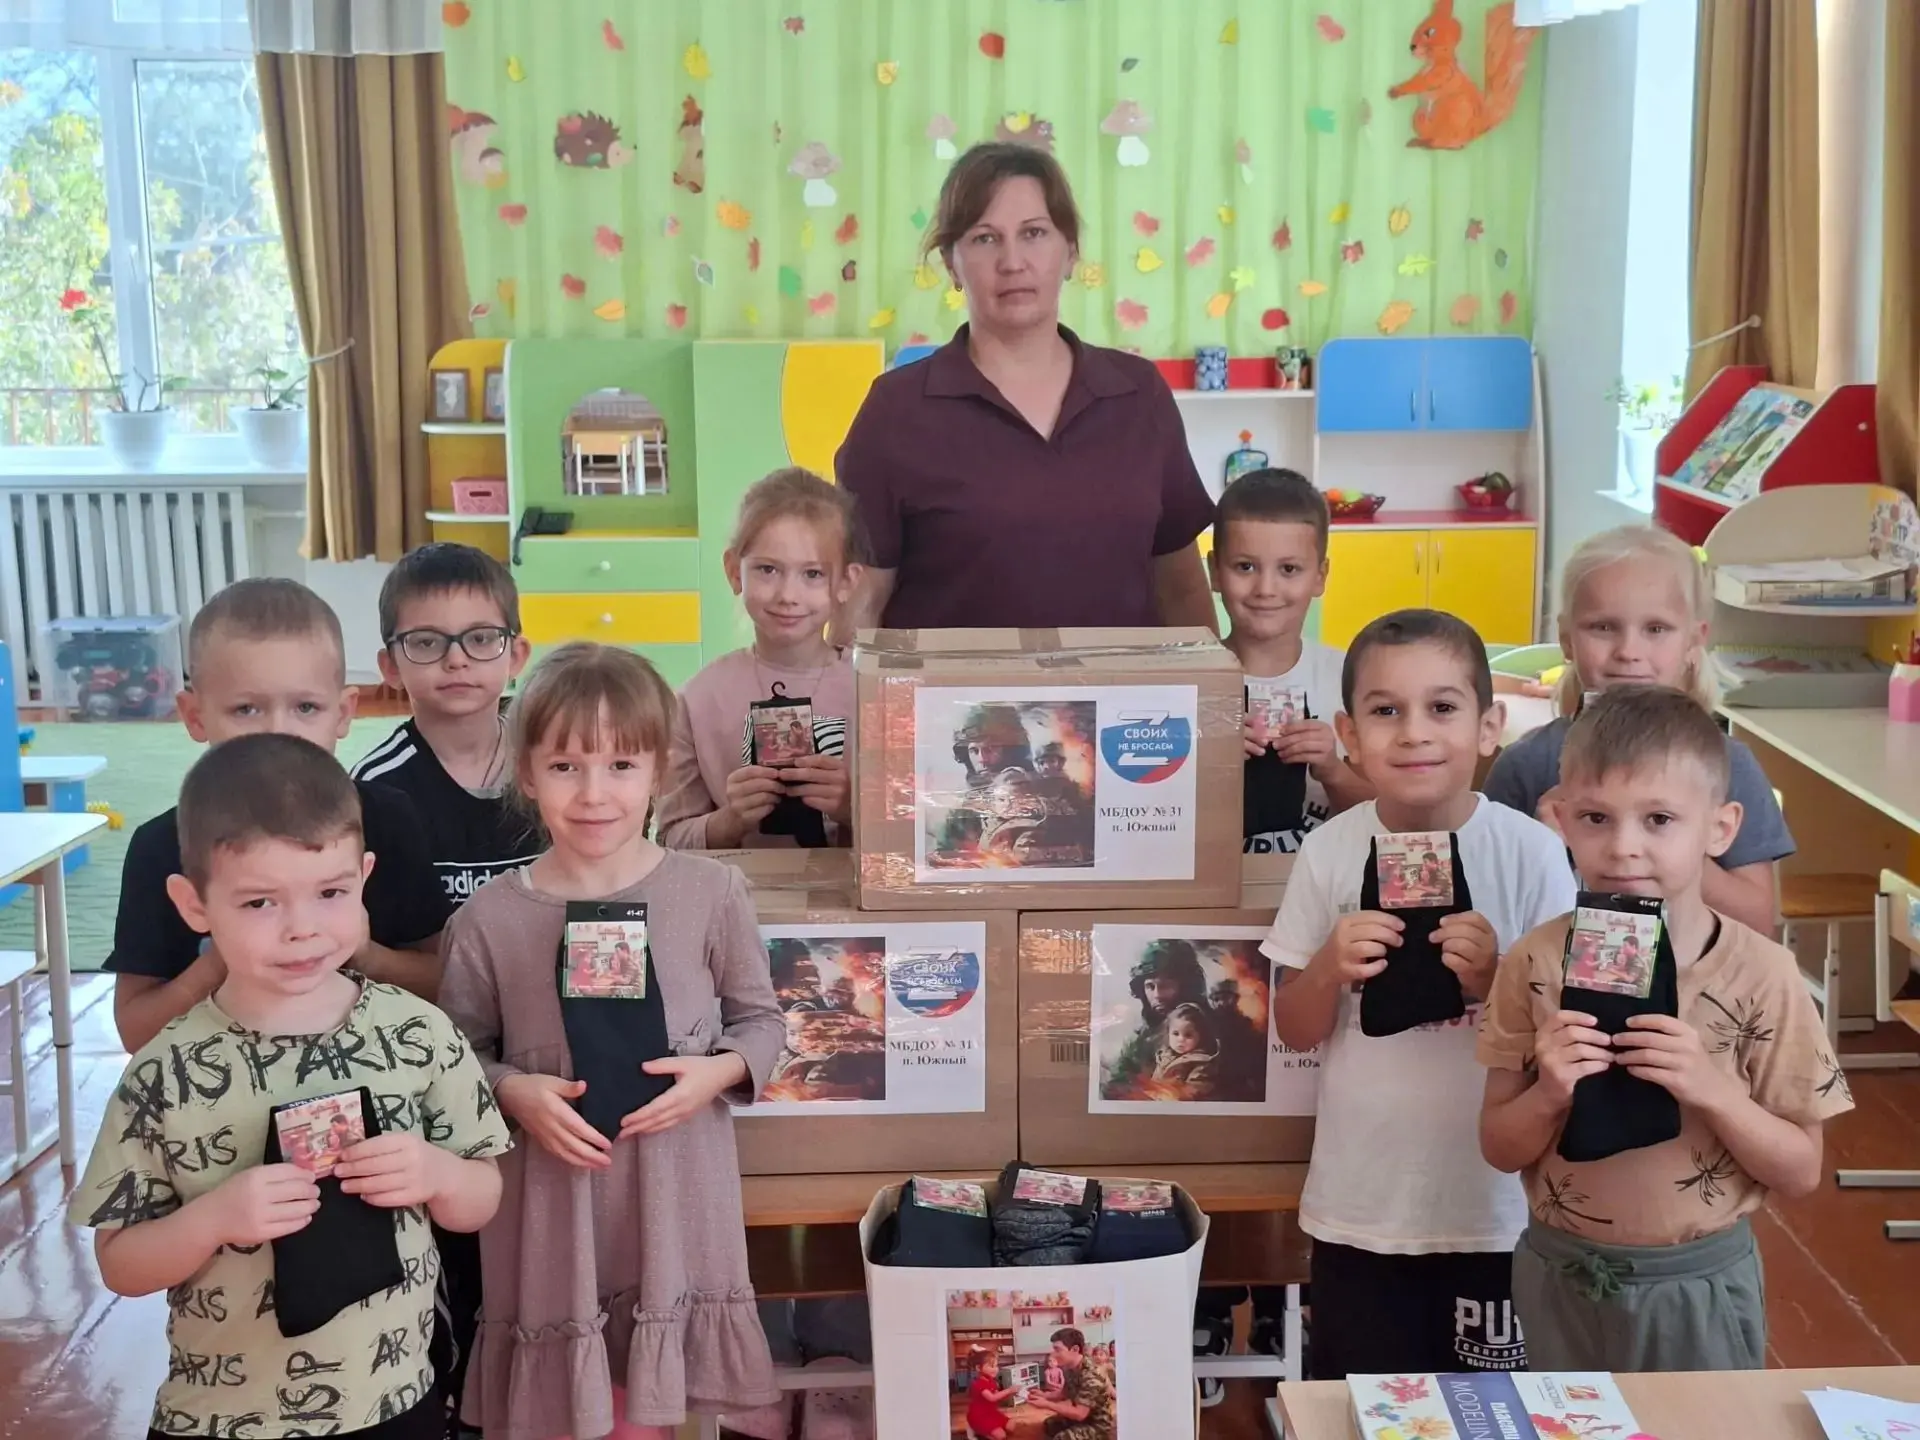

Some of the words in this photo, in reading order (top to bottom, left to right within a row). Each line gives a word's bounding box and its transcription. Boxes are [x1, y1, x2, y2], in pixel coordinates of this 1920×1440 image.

[1123, 728, 1169, 739] СВОИХ
[1118, 742, 1129, 751] НЕ
[1131, 742, 1174, 751] БРОСАЕМ
[1099, 807, 1149, 819] МБДОУ
[1169, 806, 1182, 817] 31
[1127, 821, 1176, 832] Южный
[890, 1041, 937, 1052] МБДОУ
[236, 1014, 435, 1096] PARIS
[902, 1058, 913, 1066] п.
[918, 1055, 967, 1066] Южный
